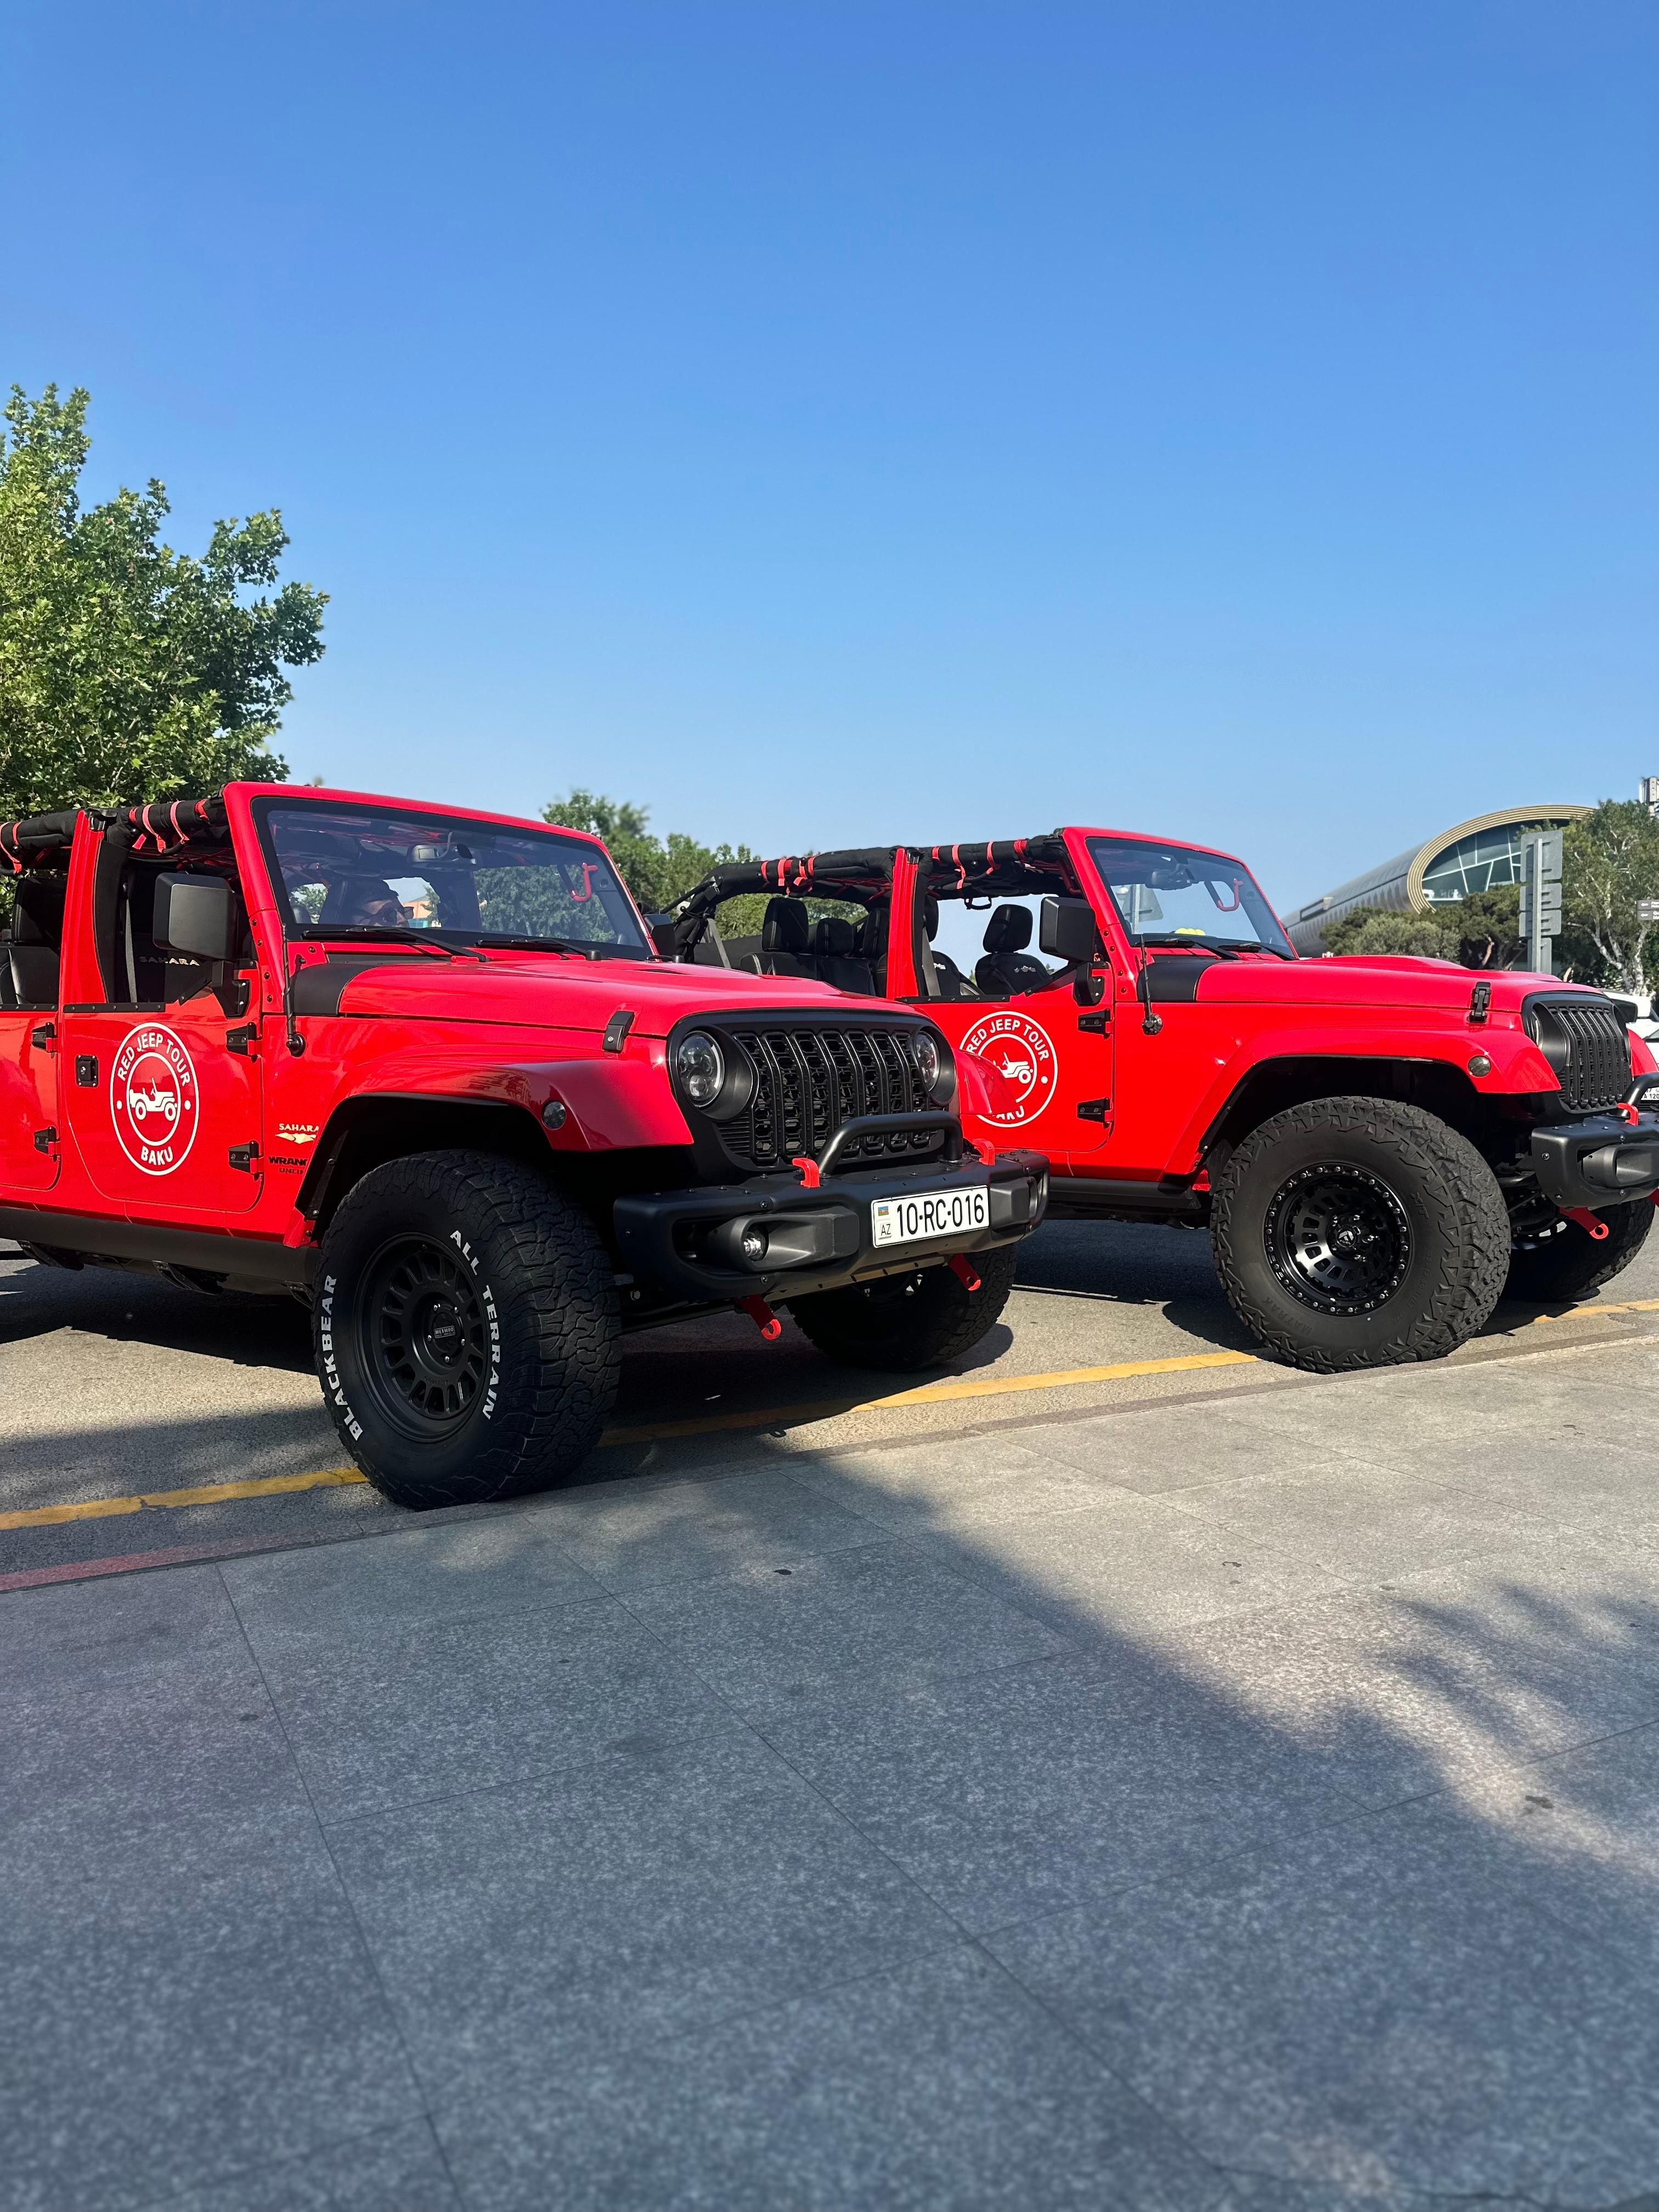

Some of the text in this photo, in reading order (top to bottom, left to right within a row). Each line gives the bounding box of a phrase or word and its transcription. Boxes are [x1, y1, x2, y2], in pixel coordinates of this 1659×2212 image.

[139, 956, 200, 966] SAHARA
[966, 1018, 1049, 1061] RED JEEP TOUR
[117, 1032, 190, 1087] RED JEEP TOUR
[279, 1123, 319, 1132] SAHARA
[140, 1146, 173, 1166] BAKU
[881, 1223, 891, 1236] AZ
[435, 1327, 454, 1335] METHOD
[449, 1230, 500, 1420] ALL TERRAIN
[321, 1275, 363, 1441] BLACKBEAR
